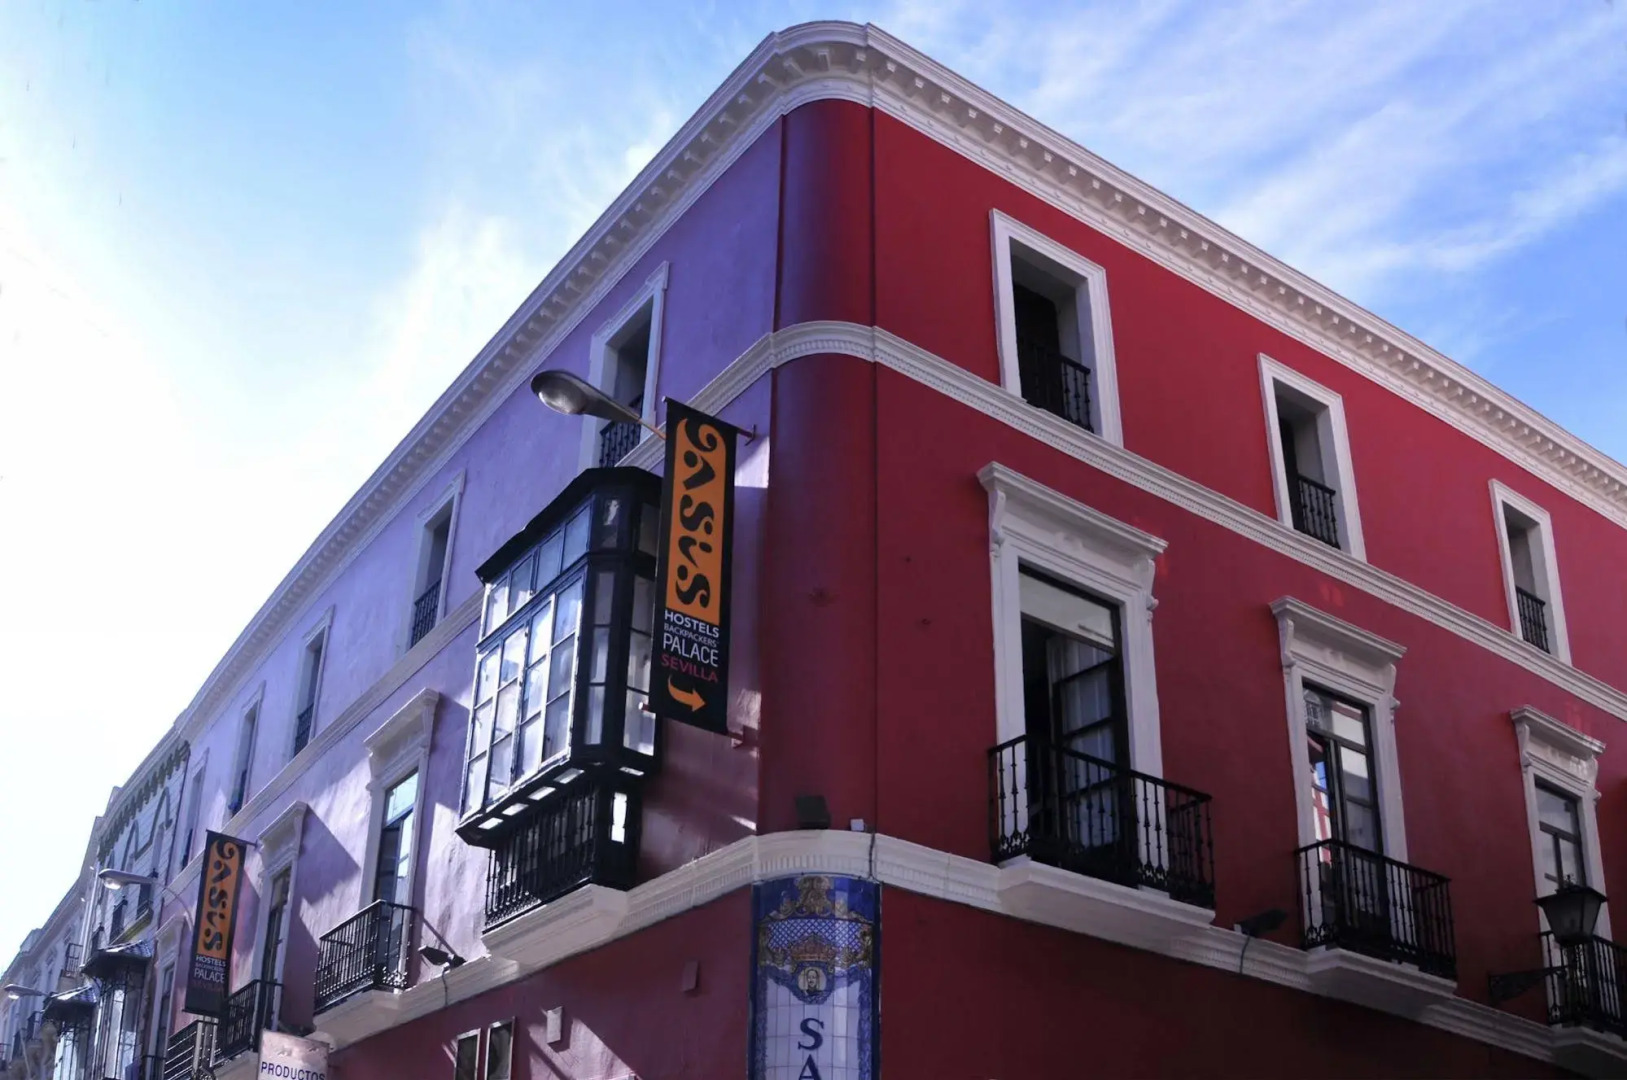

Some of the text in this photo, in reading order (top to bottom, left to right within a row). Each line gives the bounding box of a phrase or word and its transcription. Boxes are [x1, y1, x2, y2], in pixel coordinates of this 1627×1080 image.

[663, 622, 717, 648] BACKPACKERS
[664, 609, 720, 638] HOSTELS
[663, 633, 719, 668] PALACE
[661, 653, 718, 683] SEVILLA
[195, 955, 226, 967] HOSTELS
[194, 968, 225, 983] PALACE
[260, 1061, 326, 1080] PRODUCTOS
